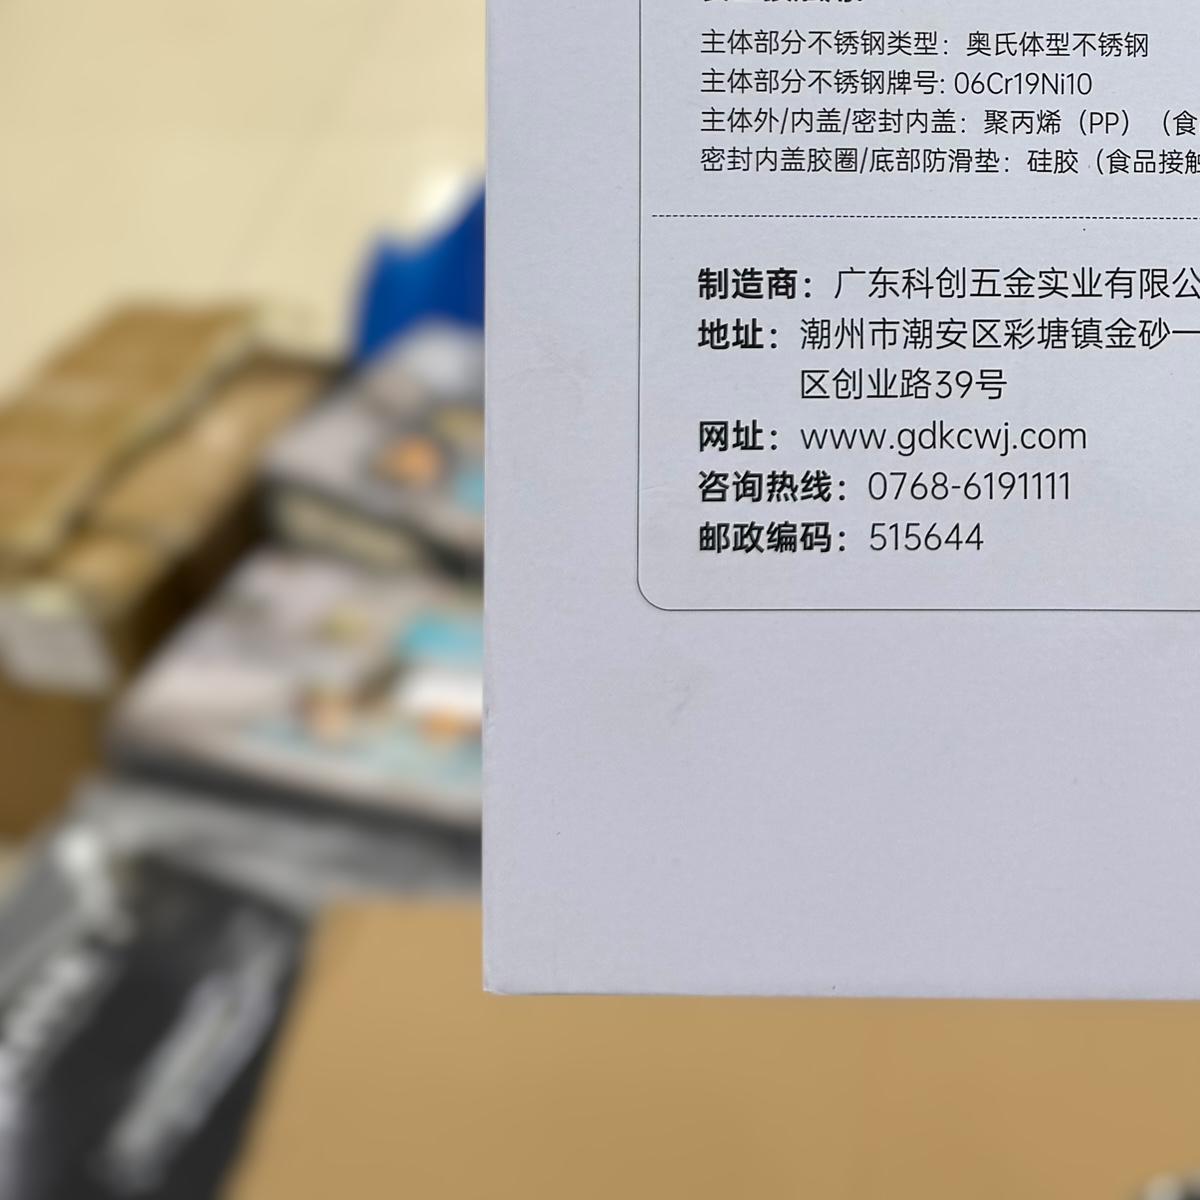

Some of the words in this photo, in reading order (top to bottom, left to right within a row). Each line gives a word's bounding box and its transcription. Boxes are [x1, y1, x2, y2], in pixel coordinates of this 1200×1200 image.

[800, 366, 1008, 401] 区创业路39号
[799, 419, 1087, 457] www.gdkcwj.com
[867, 471, 1069, 501] 0768-6191111
[869, 522, 985, 552] 515644
